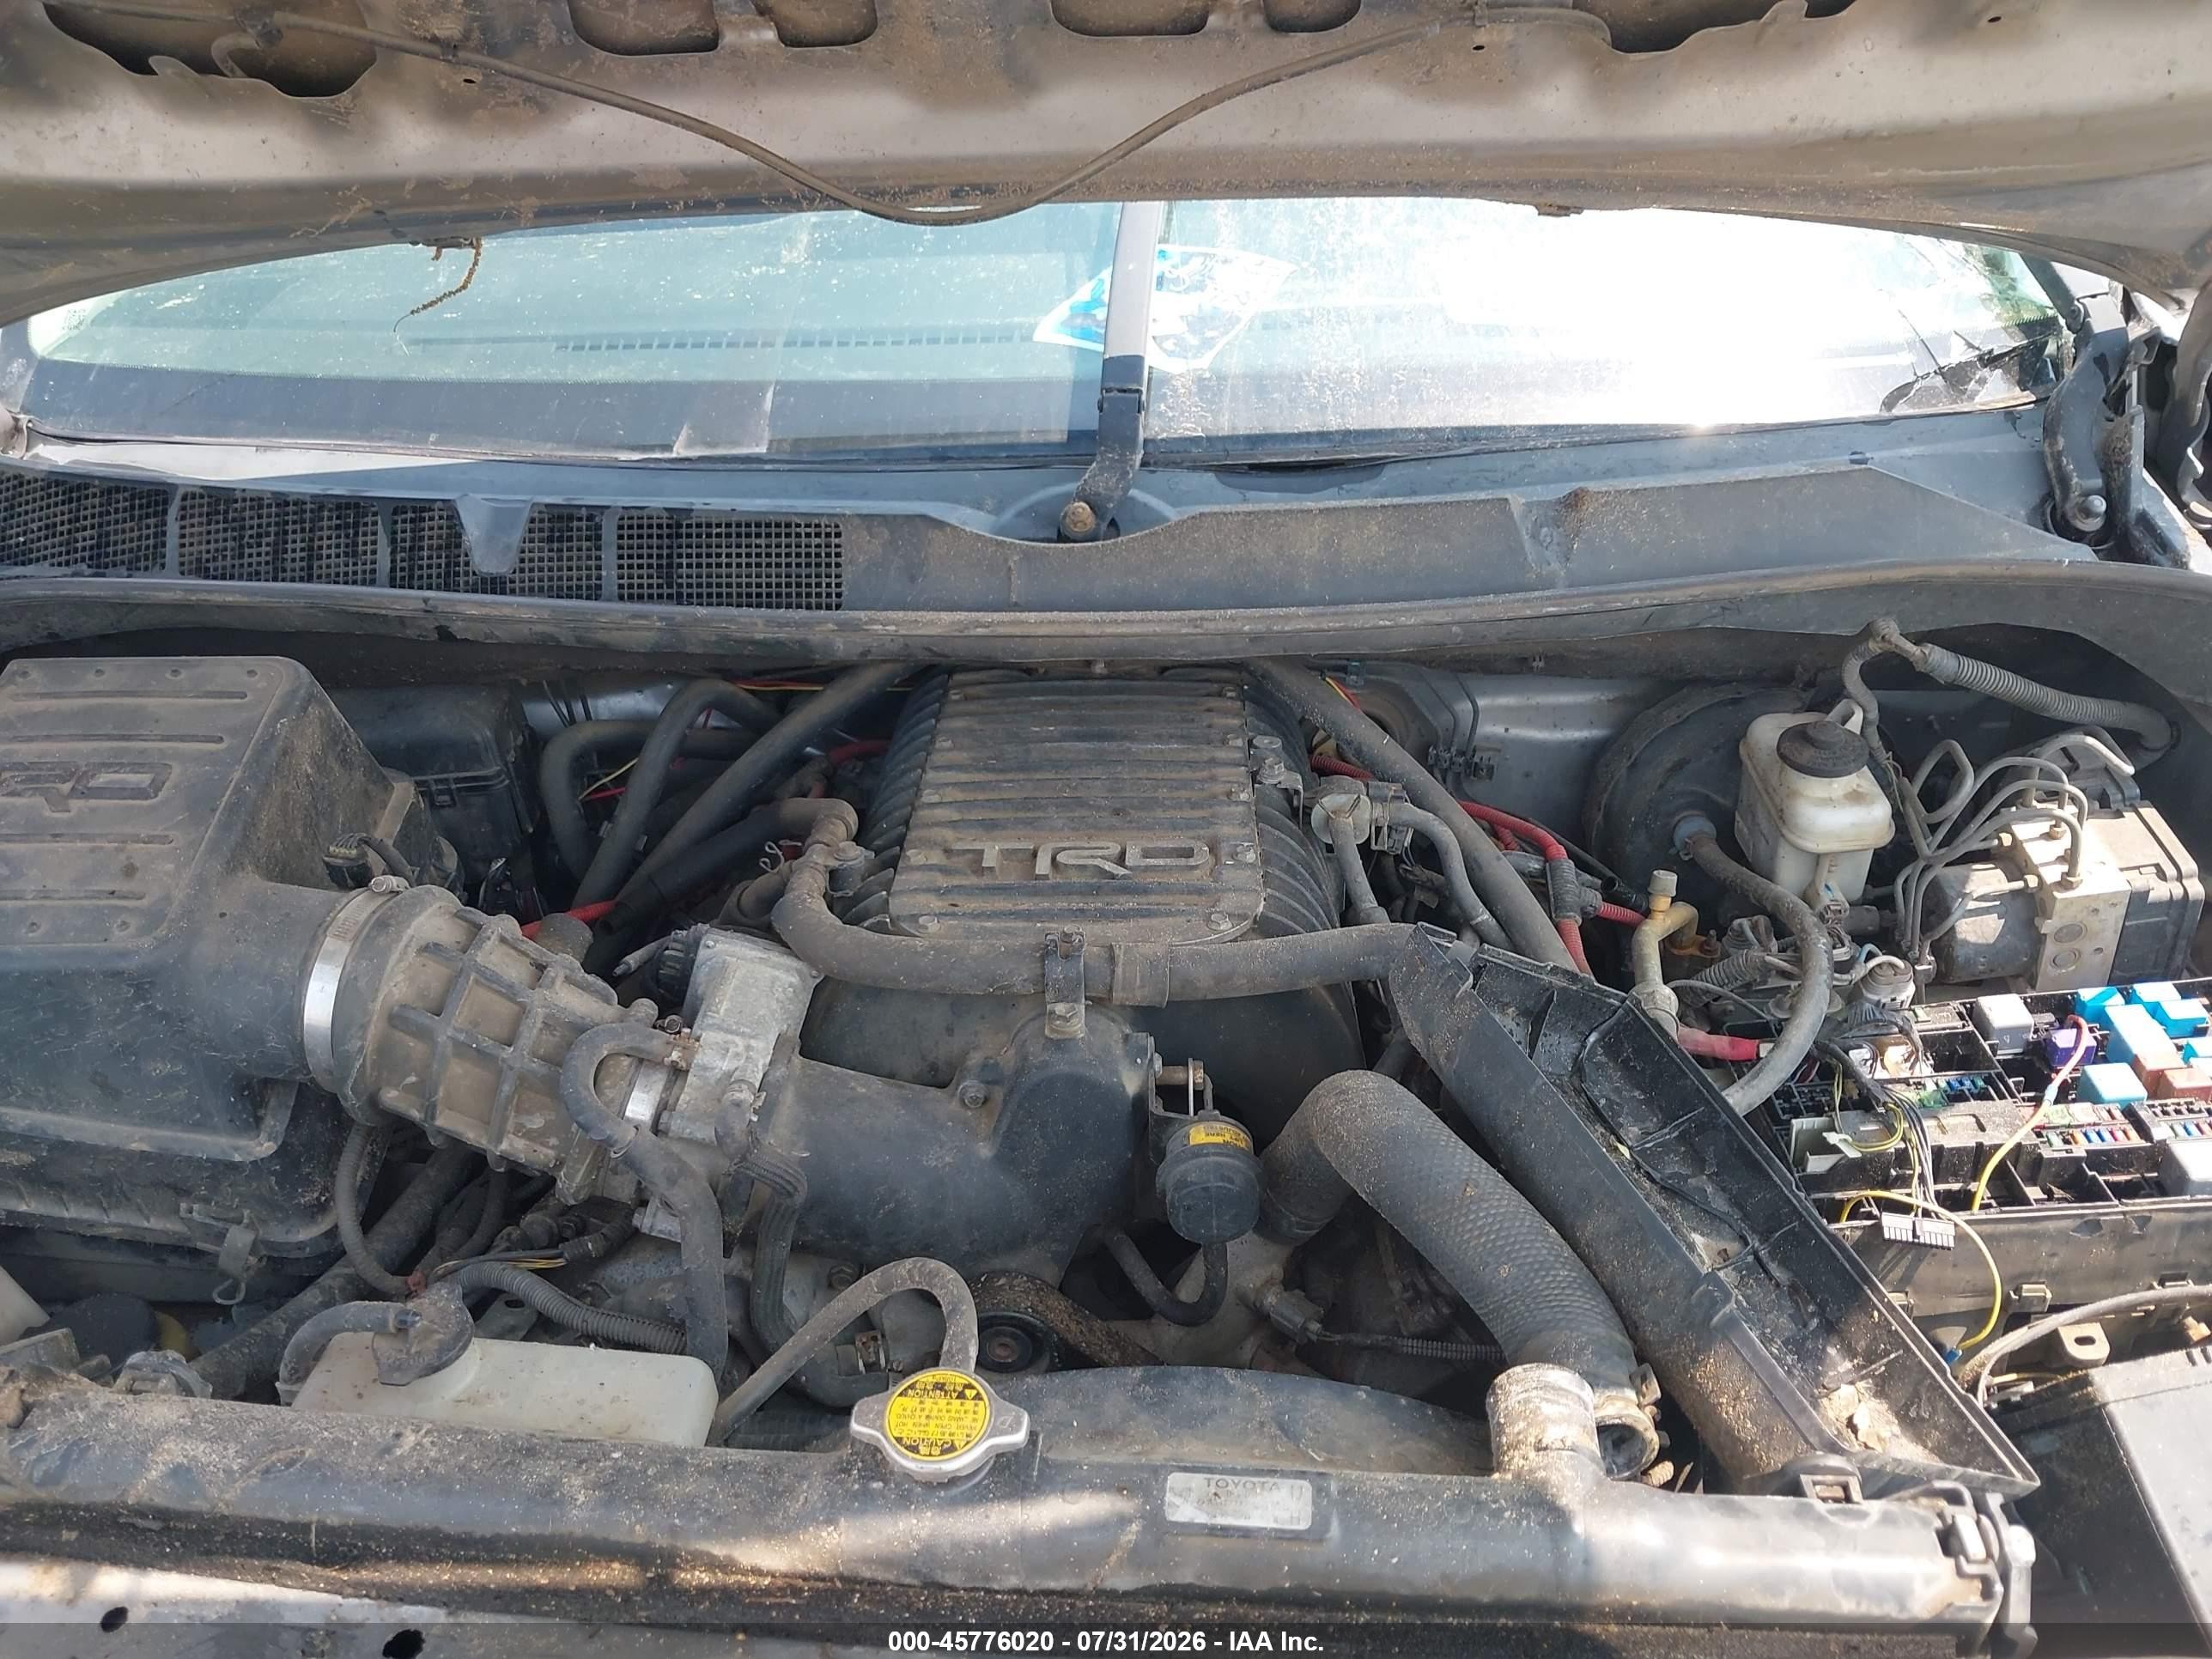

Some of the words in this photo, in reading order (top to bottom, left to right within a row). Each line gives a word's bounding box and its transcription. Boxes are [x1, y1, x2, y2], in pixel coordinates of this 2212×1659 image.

[0, 761, 173, 813] RD
[951, 840, 1211, 881] TRD
[907, 1389, 958, 1399] ATTENTION
[902, 1437, 952, 1447] CAUTION
[1204, 1477, 1280, 1492] TOYOTA
